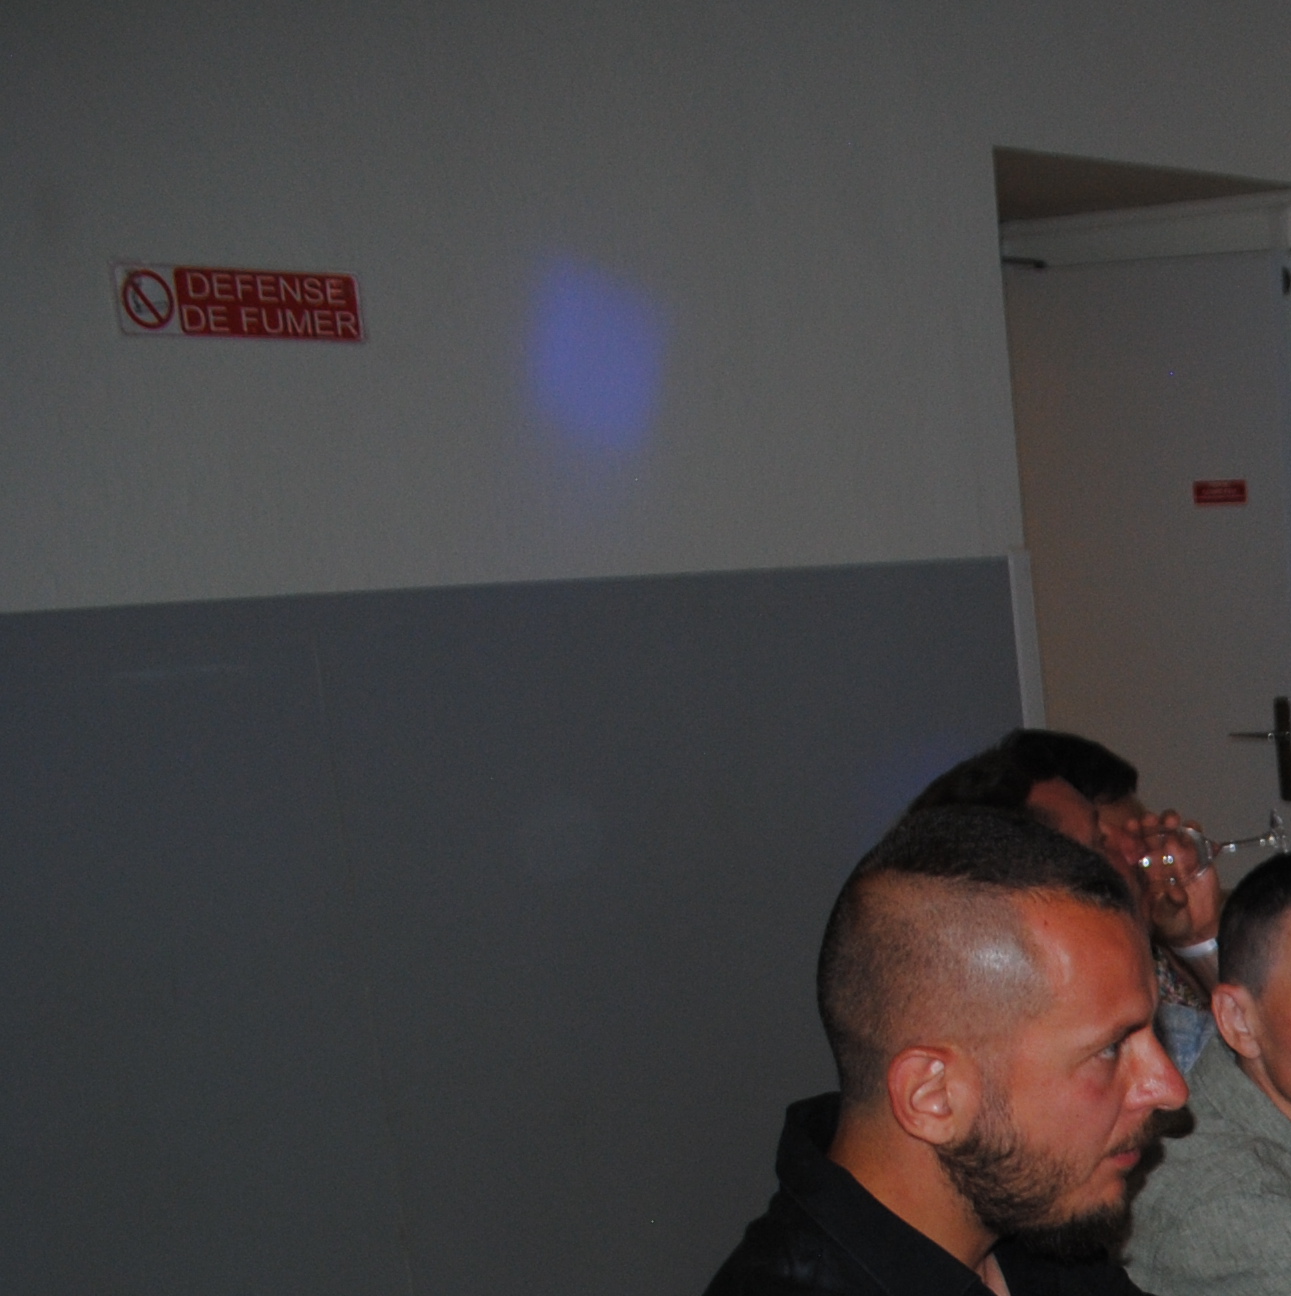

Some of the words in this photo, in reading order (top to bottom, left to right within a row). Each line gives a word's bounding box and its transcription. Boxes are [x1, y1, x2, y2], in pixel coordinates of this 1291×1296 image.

[185, 271, 346, 305] DEFENSE
[182, 304, 230, 332] DE
[240, 307, 359, 337] FUMER
